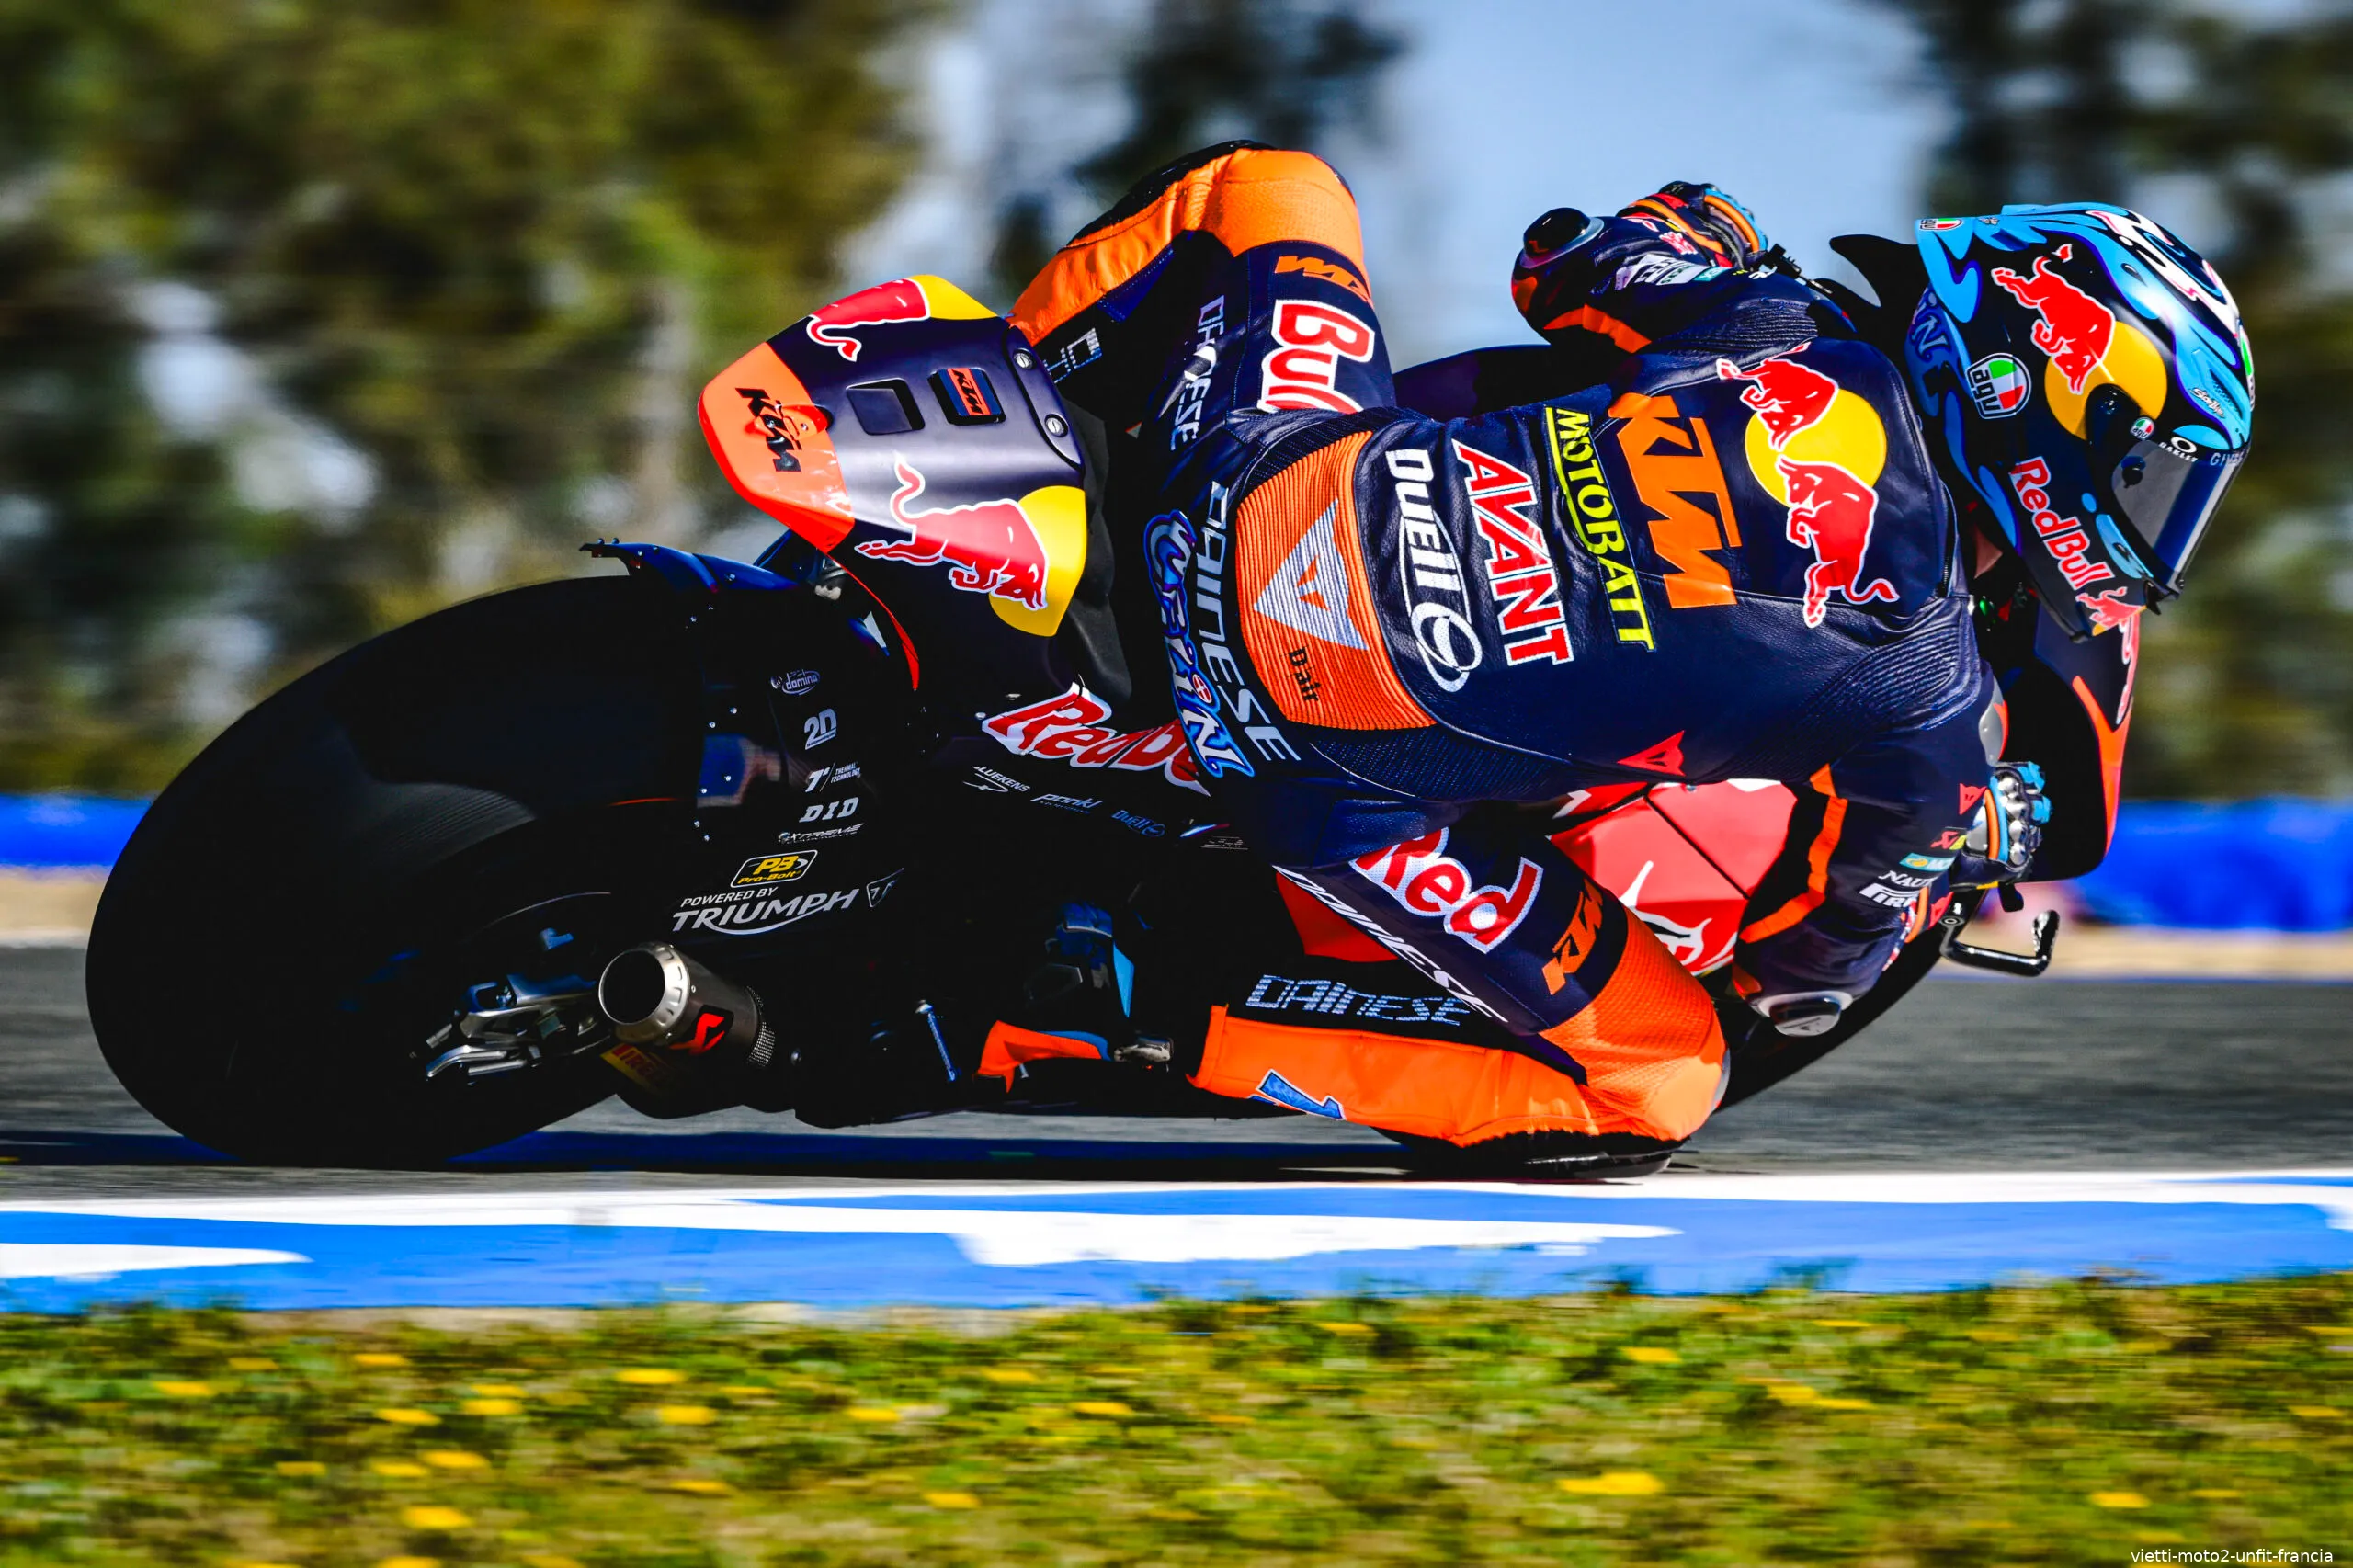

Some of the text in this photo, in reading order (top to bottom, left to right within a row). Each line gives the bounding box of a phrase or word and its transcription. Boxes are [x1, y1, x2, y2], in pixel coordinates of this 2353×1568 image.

[1274, 256, 1373, 304] KTM
[953, 369, 983, 415] KTM
[1972, 369, 2001, 411] agv
[734, 387, 803, 472] KTM
[2158, 441, 2200, 463] OAKLEY
[1608, 392, 1743, 609] KTM
[1451, 437, 1575, 667] AVANT
[1552, 405, 1655, 651] MOTOBATT
[1195, 480, 1302, 762] DAINESE
[785, 672, 820, 690] domino
[835, 762, 858, 776] THERMAL
[752, 855, 800, 875] PB
[672, 888, 860, 933] TRIUMPH
[680, 886, 779, 908] POWERED BY
[1348, 827, 1544, 954] Red
[1541, 878, 1604, 995] KTM
[1246, 974, 1472, 1027] DAINESE
